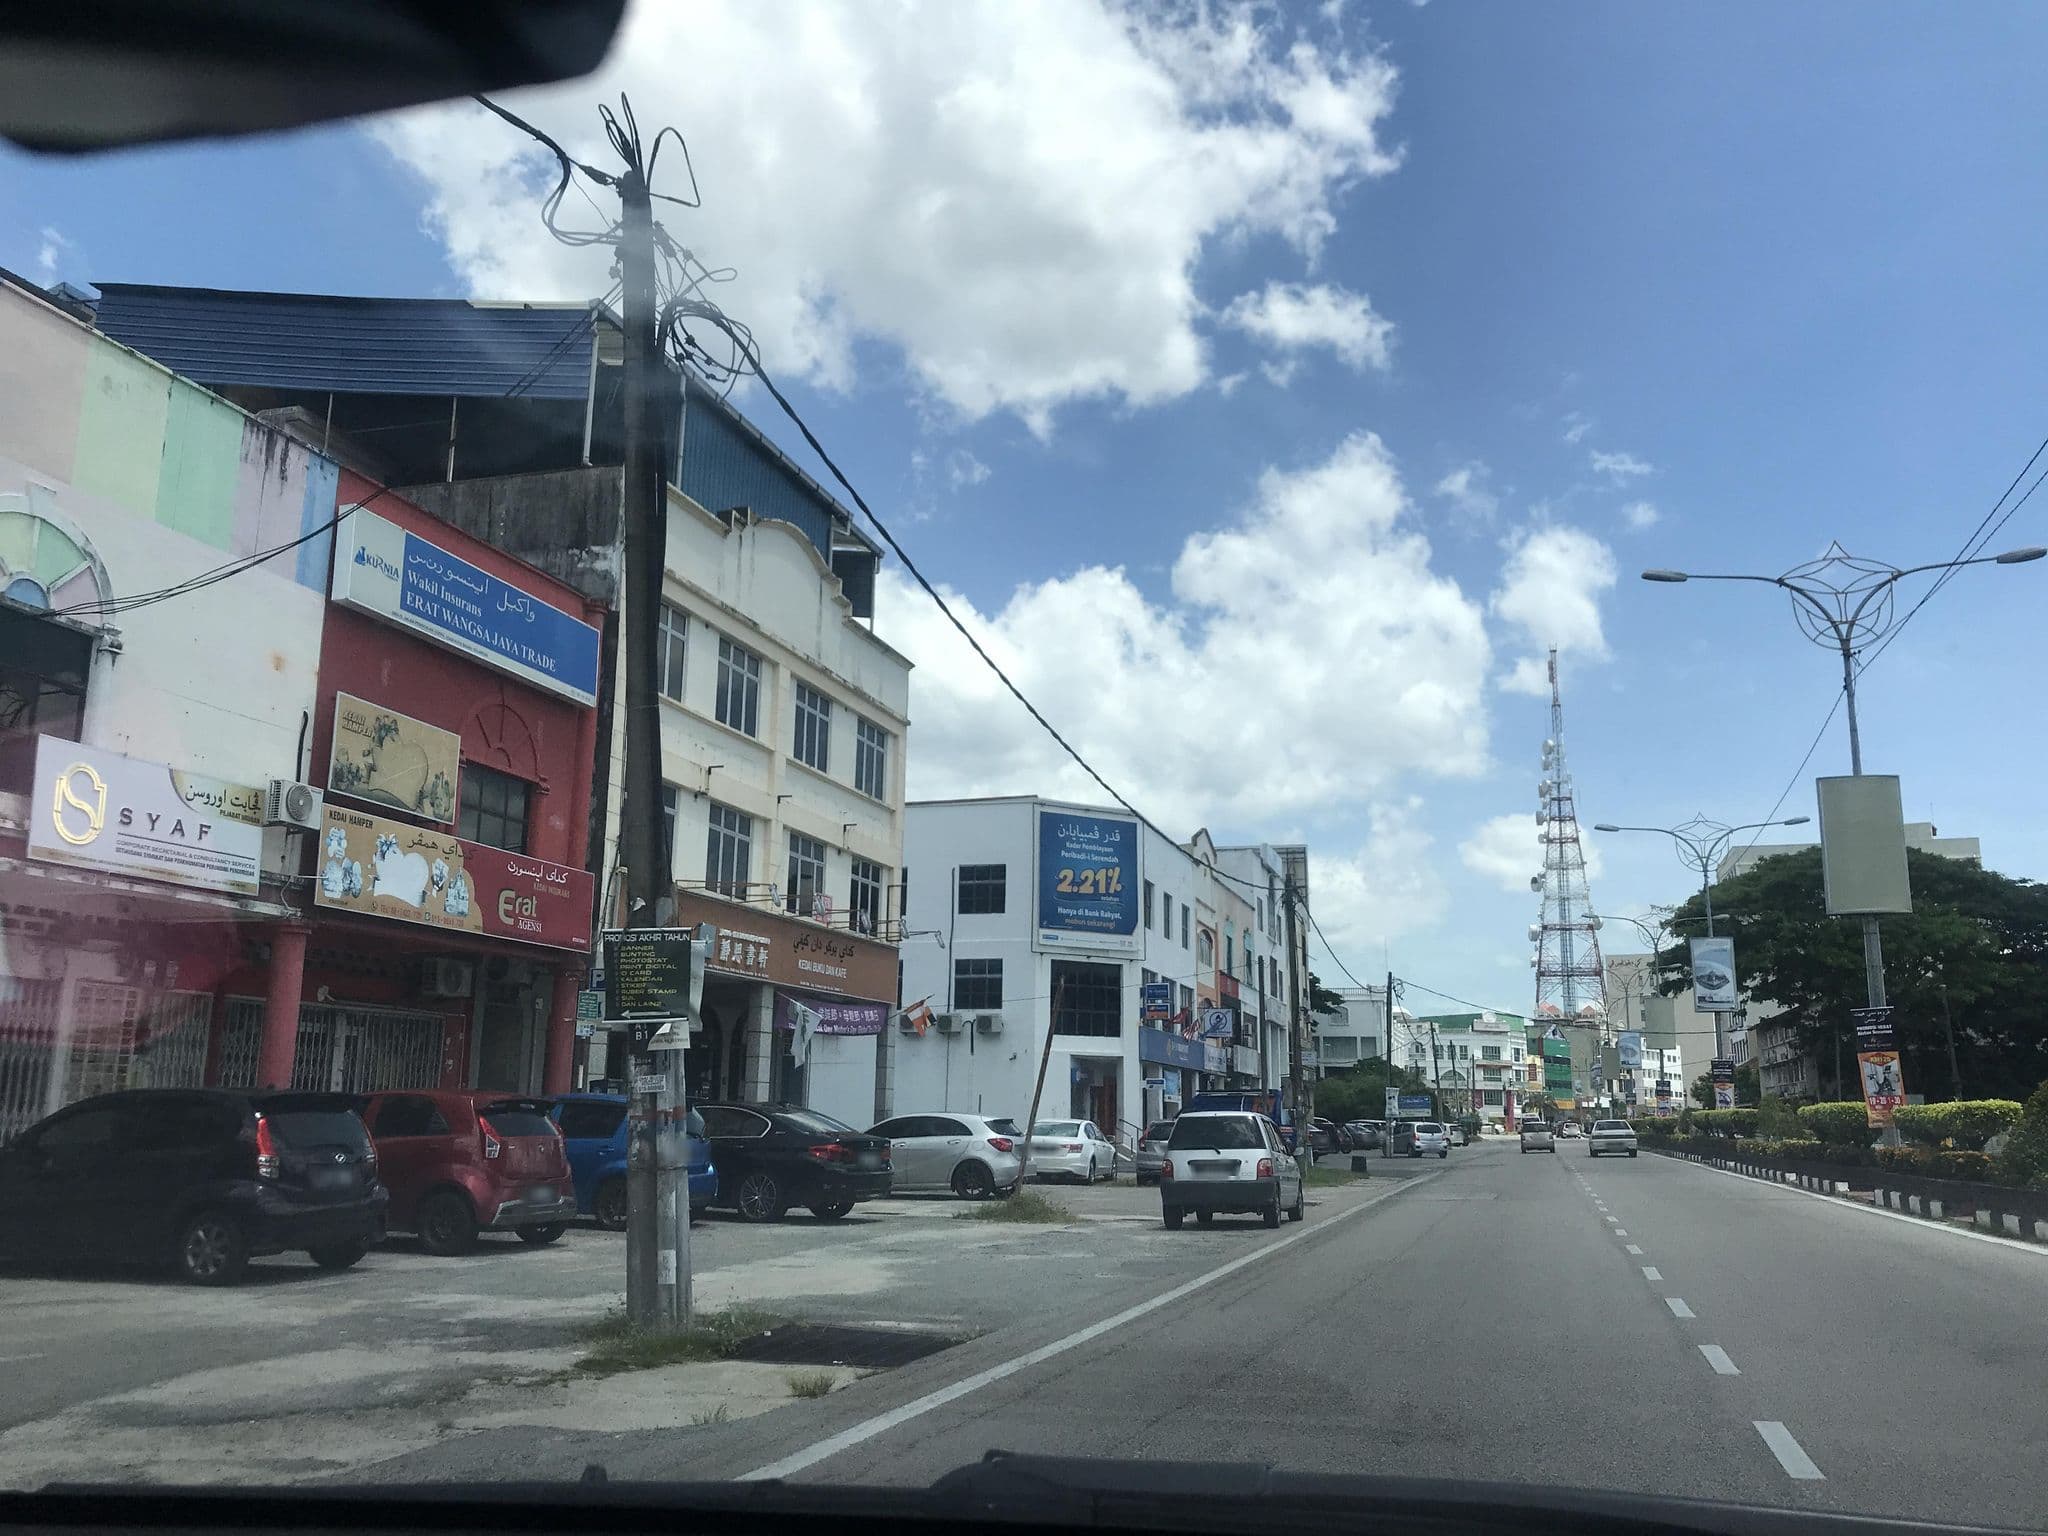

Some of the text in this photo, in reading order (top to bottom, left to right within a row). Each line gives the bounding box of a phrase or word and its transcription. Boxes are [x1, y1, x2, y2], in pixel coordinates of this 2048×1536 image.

[366, 554, 400, 579] KURNIA
[408, 570, 482, 617] Wakil Insurans
[406, 591, 441, 618] ERAT
[442, 607, 490, 642] WANGSA
[492, 631, 519, 656] JAYA
[520, 645, 556, 672] TRADE
[119, 807, 211, 841] SYAF
[1056, 867, 1122, 894] 2.21%
[498, 890, 538, 926] Erat
[517, 920, 542, 932] AGENSI
[664, 933, 690, 941] TAHUN
[592, 969, 605, 988] P
[635, 1031, 648, 1040] B1
